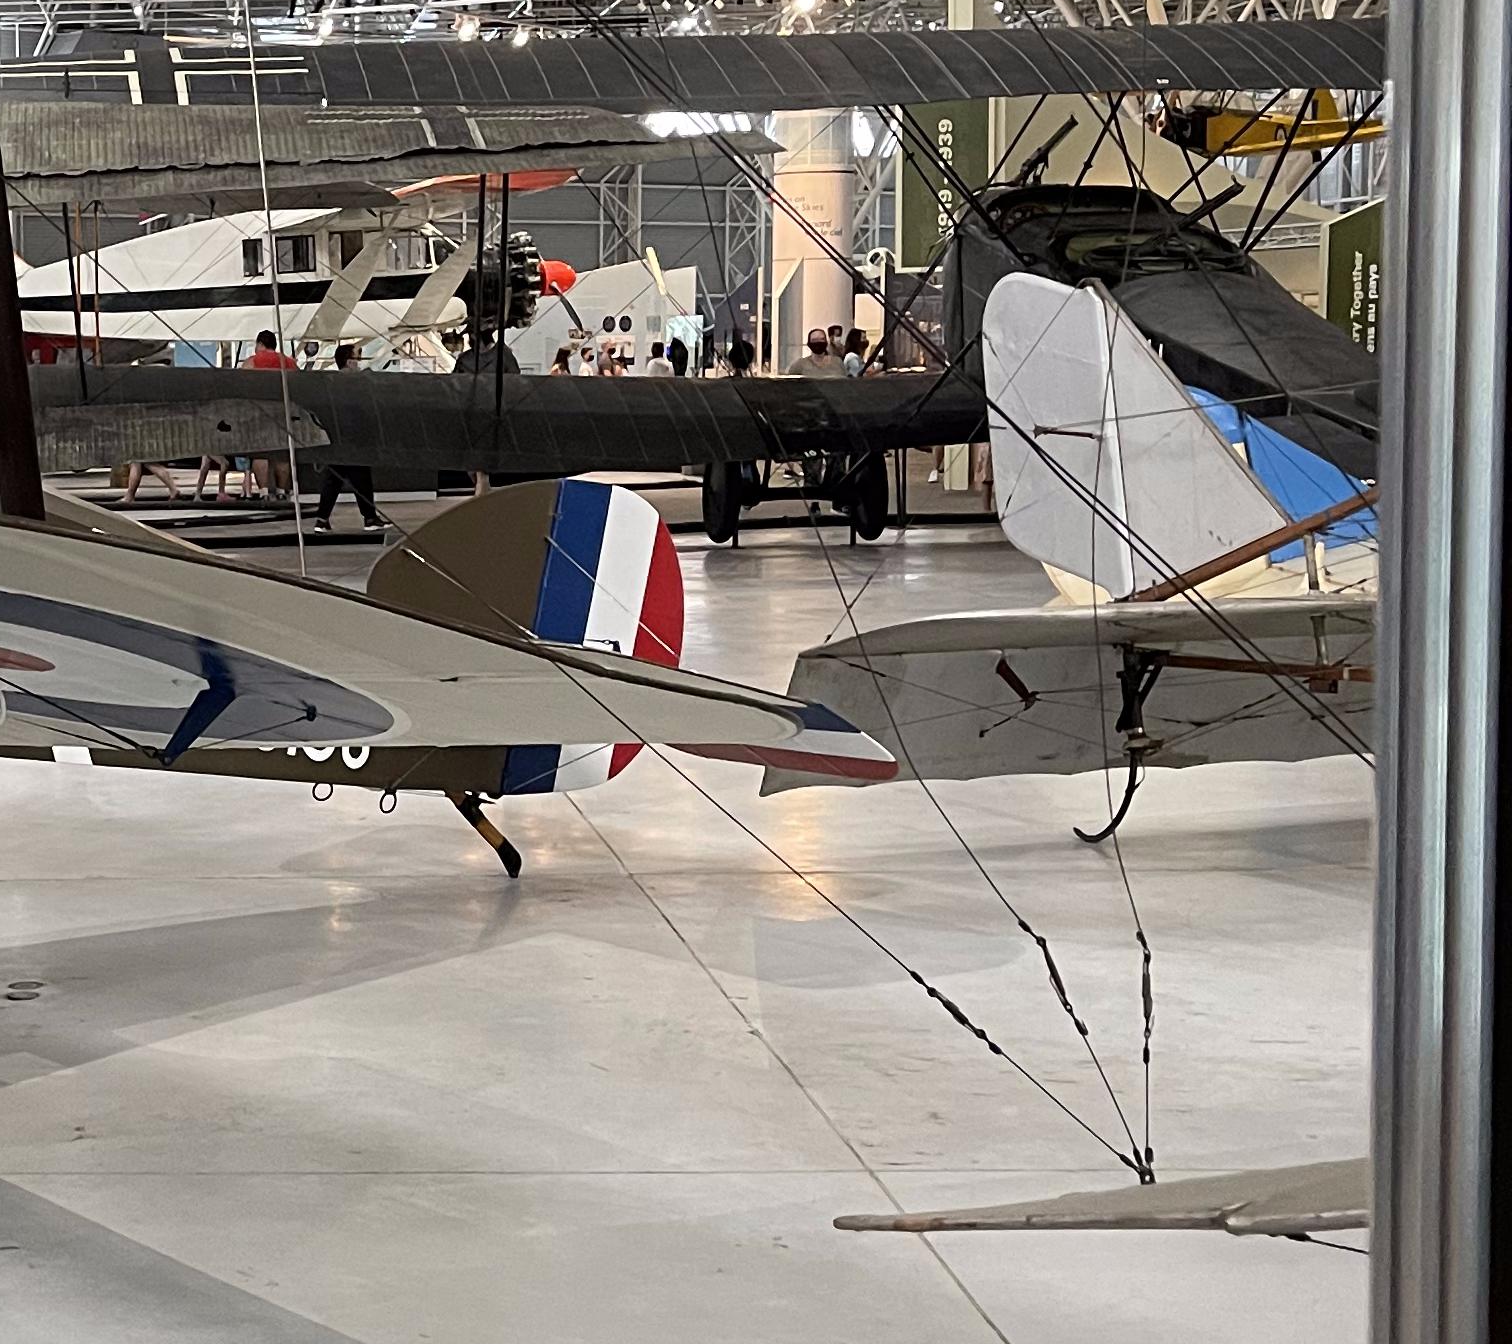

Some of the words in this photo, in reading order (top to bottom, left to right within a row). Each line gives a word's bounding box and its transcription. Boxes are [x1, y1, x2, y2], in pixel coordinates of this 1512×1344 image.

[937, 118, 953, 170] 1939
[1350, 251, 1364, 319] Together
[1368, 264, 1380, 299] pays
